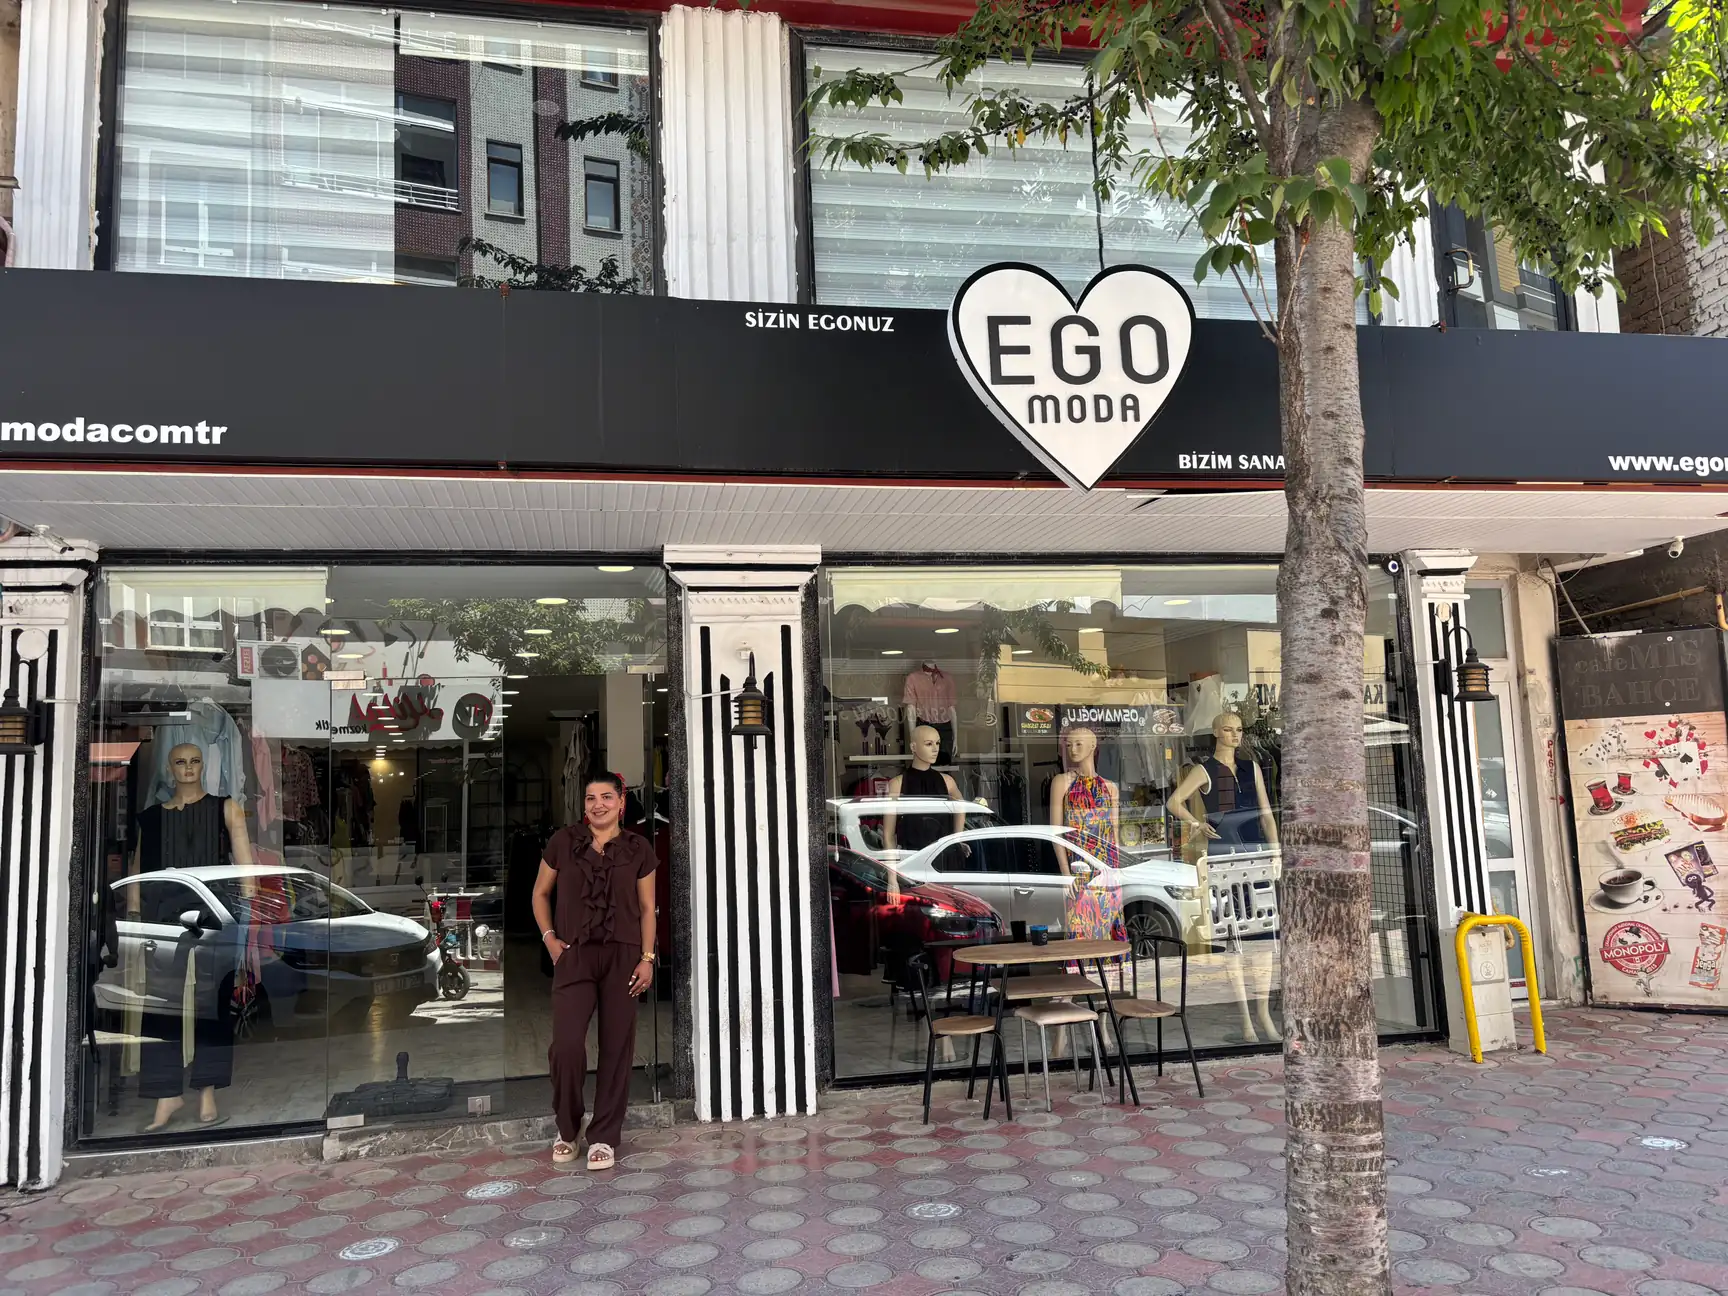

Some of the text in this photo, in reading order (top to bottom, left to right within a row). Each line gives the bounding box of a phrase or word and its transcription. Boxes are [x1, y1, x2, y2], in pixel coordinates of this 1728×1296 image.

[745, 309, 895, 332] SİZİN EGONUZ
[987, 314, 1170, 385] EGO
[1028, 393, 1141, 424] MODA
[1, 416, 228, 444] modacomtr
[1178, 450, 1286, 470] BİZİM SANA
[1604, 942, 1665, 959] MONOPOLY
